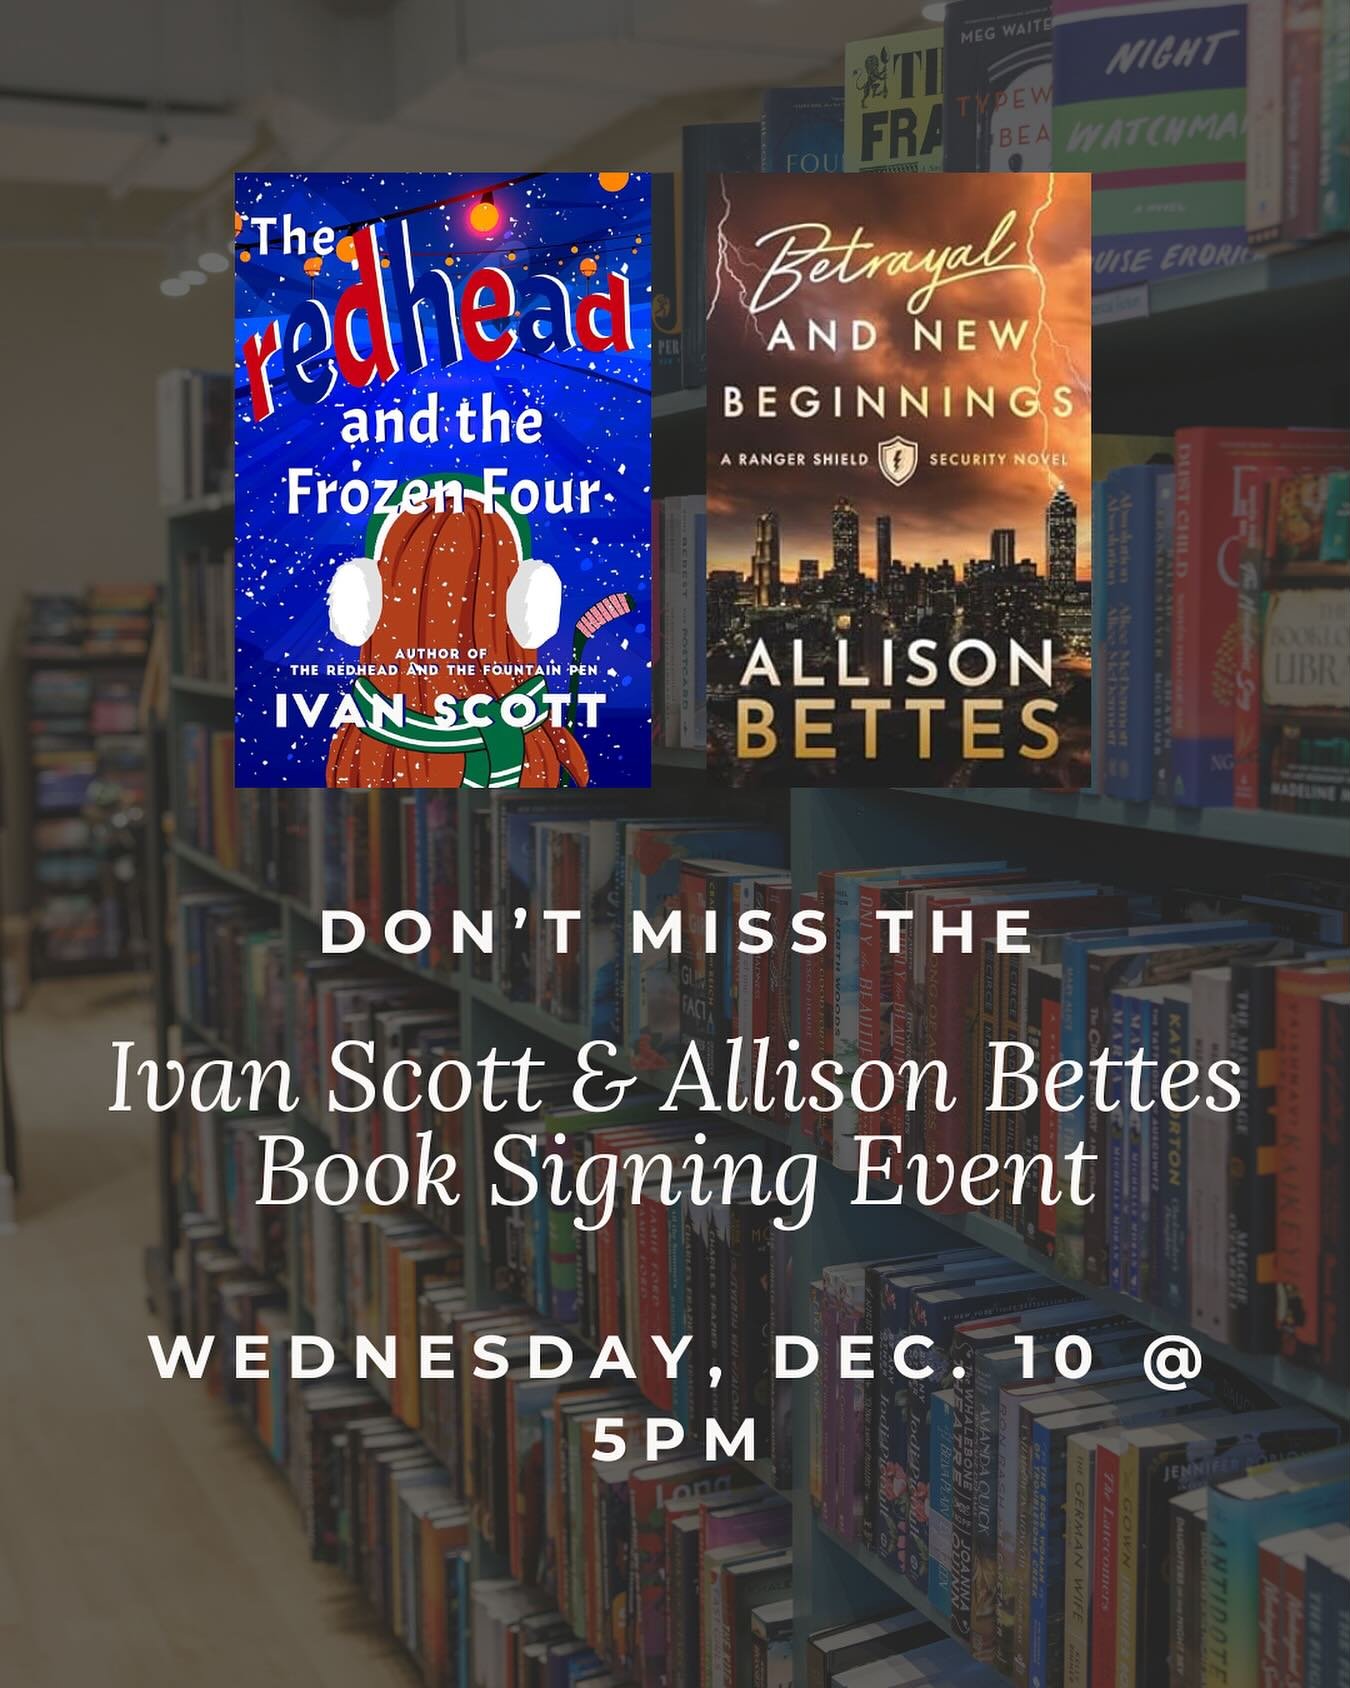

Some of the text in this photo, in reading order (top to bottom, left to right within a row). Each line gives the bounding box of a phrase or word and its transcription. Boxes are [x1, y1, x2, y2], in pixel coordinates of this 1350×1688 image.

[961, 18, 1051, 44] MEG WAITE
[1105, 29, 1240, 75] NIGHT
[893, 47, 943, 99] TI
[955, 86, 1052, 117] TYPEW
[861, 103, 943, 162] FRA
[999, 123, 1051, 149] BEA
[786, 152, 844, 173] FOU
[1091, 248, 1151, 274] UISE
[1175, 511, 1189, 577] CHILD
[1275, 653, 1350, 686] LIBR
[1112, 1008, 1124, 1082] MARA
[686, 1287, 694, 1342] FRAZIE
[963, 1388, 973, 1492] WHALEBONE
[977, 1404, 991, 1536] AMANDA QUICK
[1073, 1481, 1086, 1570] GERMAN
[1100, 1471, 1115, 1612] The Latecomers
[1122, 1496, 1133, 1568] GOWN
[960, 1539, 970, 1611] JOANNA
[1072, 1577, 1084, 1625] WIFE
[1209, 1530, 1228, 1684] ANTIDOTE
